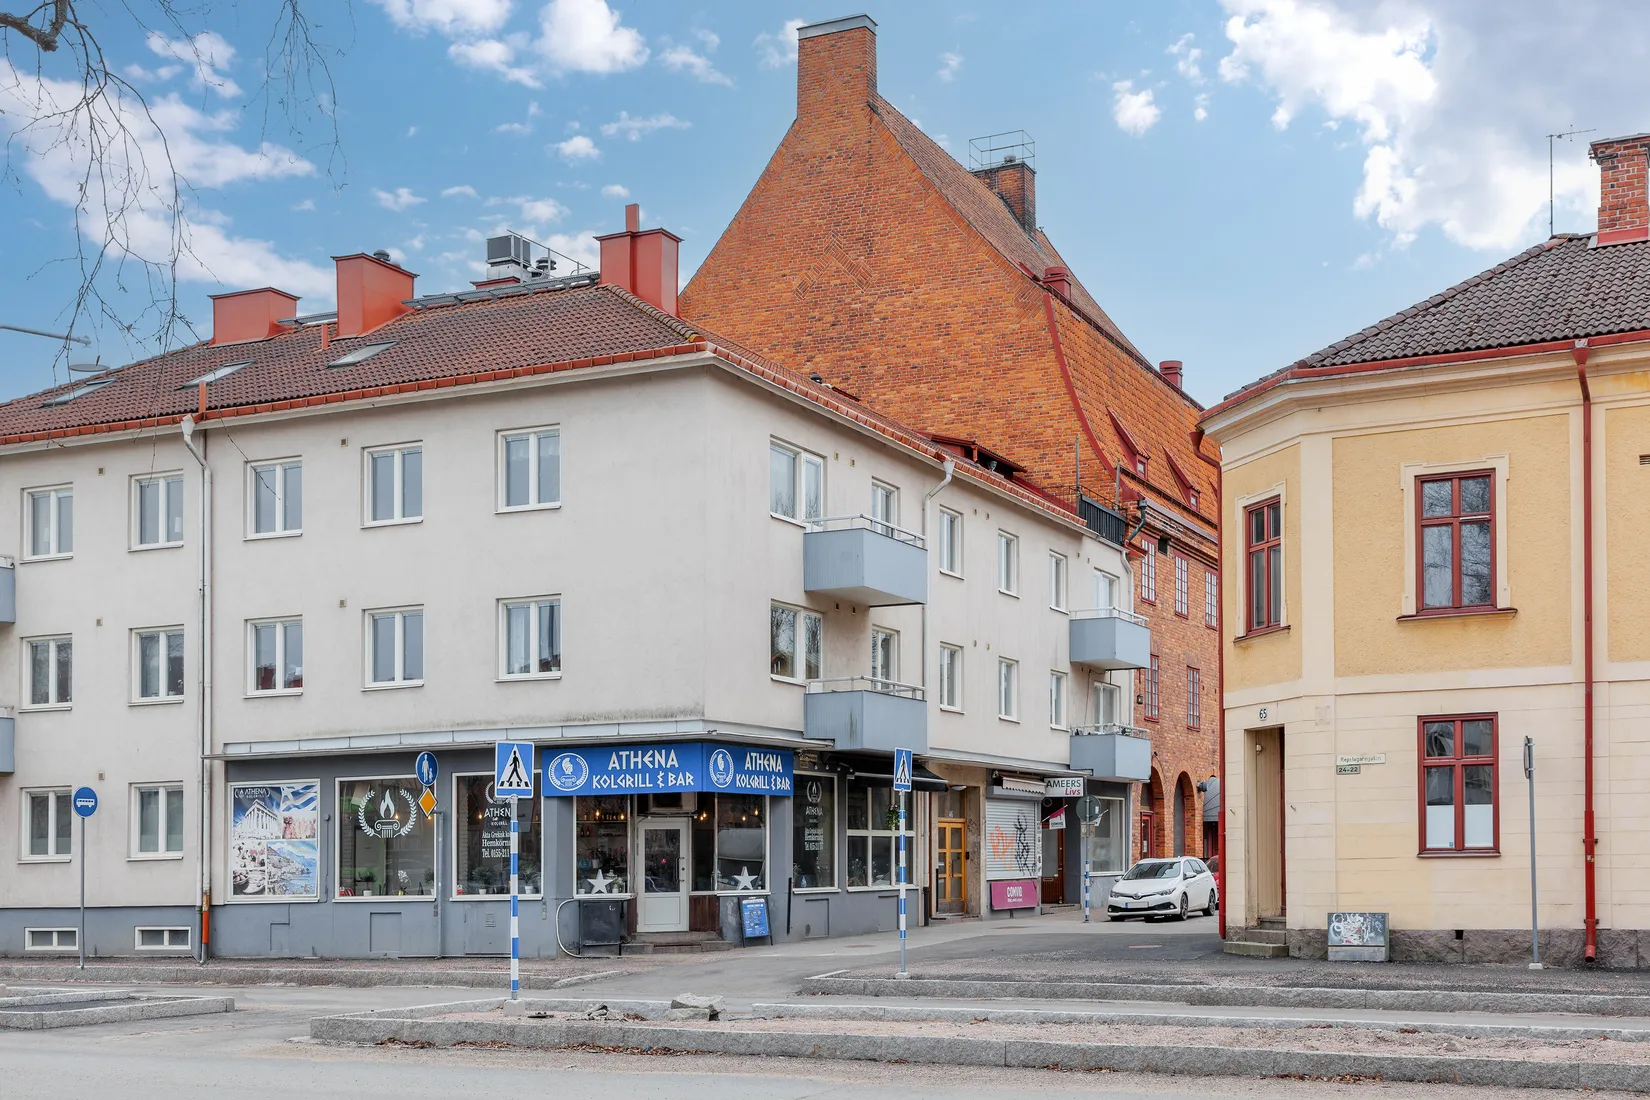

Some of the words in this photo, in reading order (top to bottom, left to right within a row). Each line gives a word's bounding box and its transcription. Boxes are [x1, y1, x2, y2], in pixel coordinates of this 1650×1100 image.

[1259, 708, 1268, 720] 65
[607, 748, 679, 771] ATHENA
[744, 751, 783, 773] ATHENA
[592, 772, 653, 789] KOLGRILL
[656, 770, 665, 789] &
[667, 771, 695, 787] BAR
[736, 773, 770, 789] KOLGRILL
[776, 775, 791, 791] BAR
[1046, 779, 1081, 788] AMEERS
[244, 787, 267, 795] ATHENA
[1064, 787, 1081, 796] Livs
[483, 807, 511, 818] ATHEN
